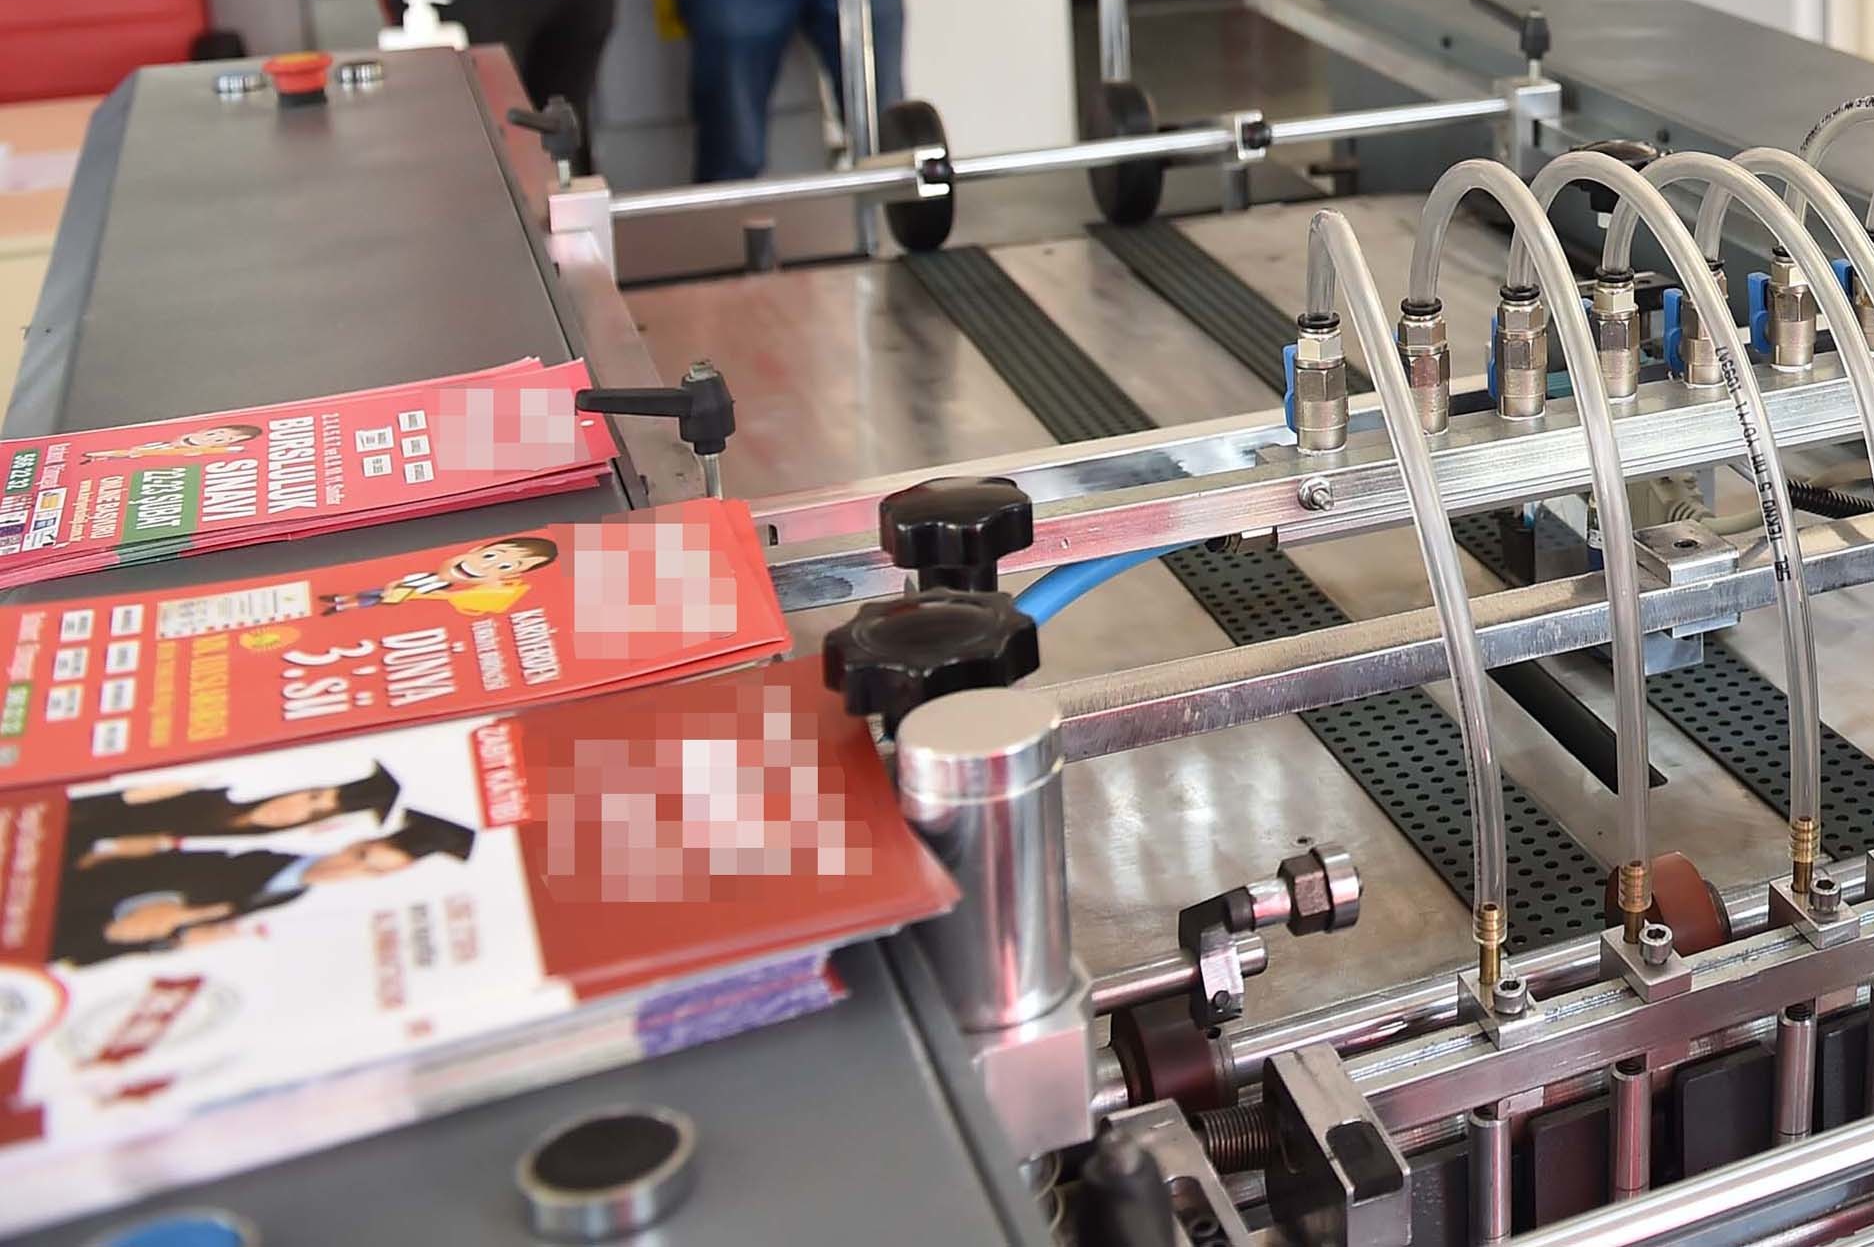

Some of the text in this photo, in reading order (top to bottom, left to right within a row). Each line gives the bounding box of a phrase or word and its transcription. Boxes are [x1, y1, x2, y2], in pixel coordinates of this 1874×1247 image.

[201, 458, 259, 523] SINAVI
[267, 415, 317, 514] BURSLULUK
[1758, 480, 1773, 493] 5
[129, 492, 185, 530] ŞUBAT
[1762, 495, 1783, 543] TEKNO
[380, 627, 465, 706] DÜNYA
[510, 607, 561, 686] KARİYERDEN
